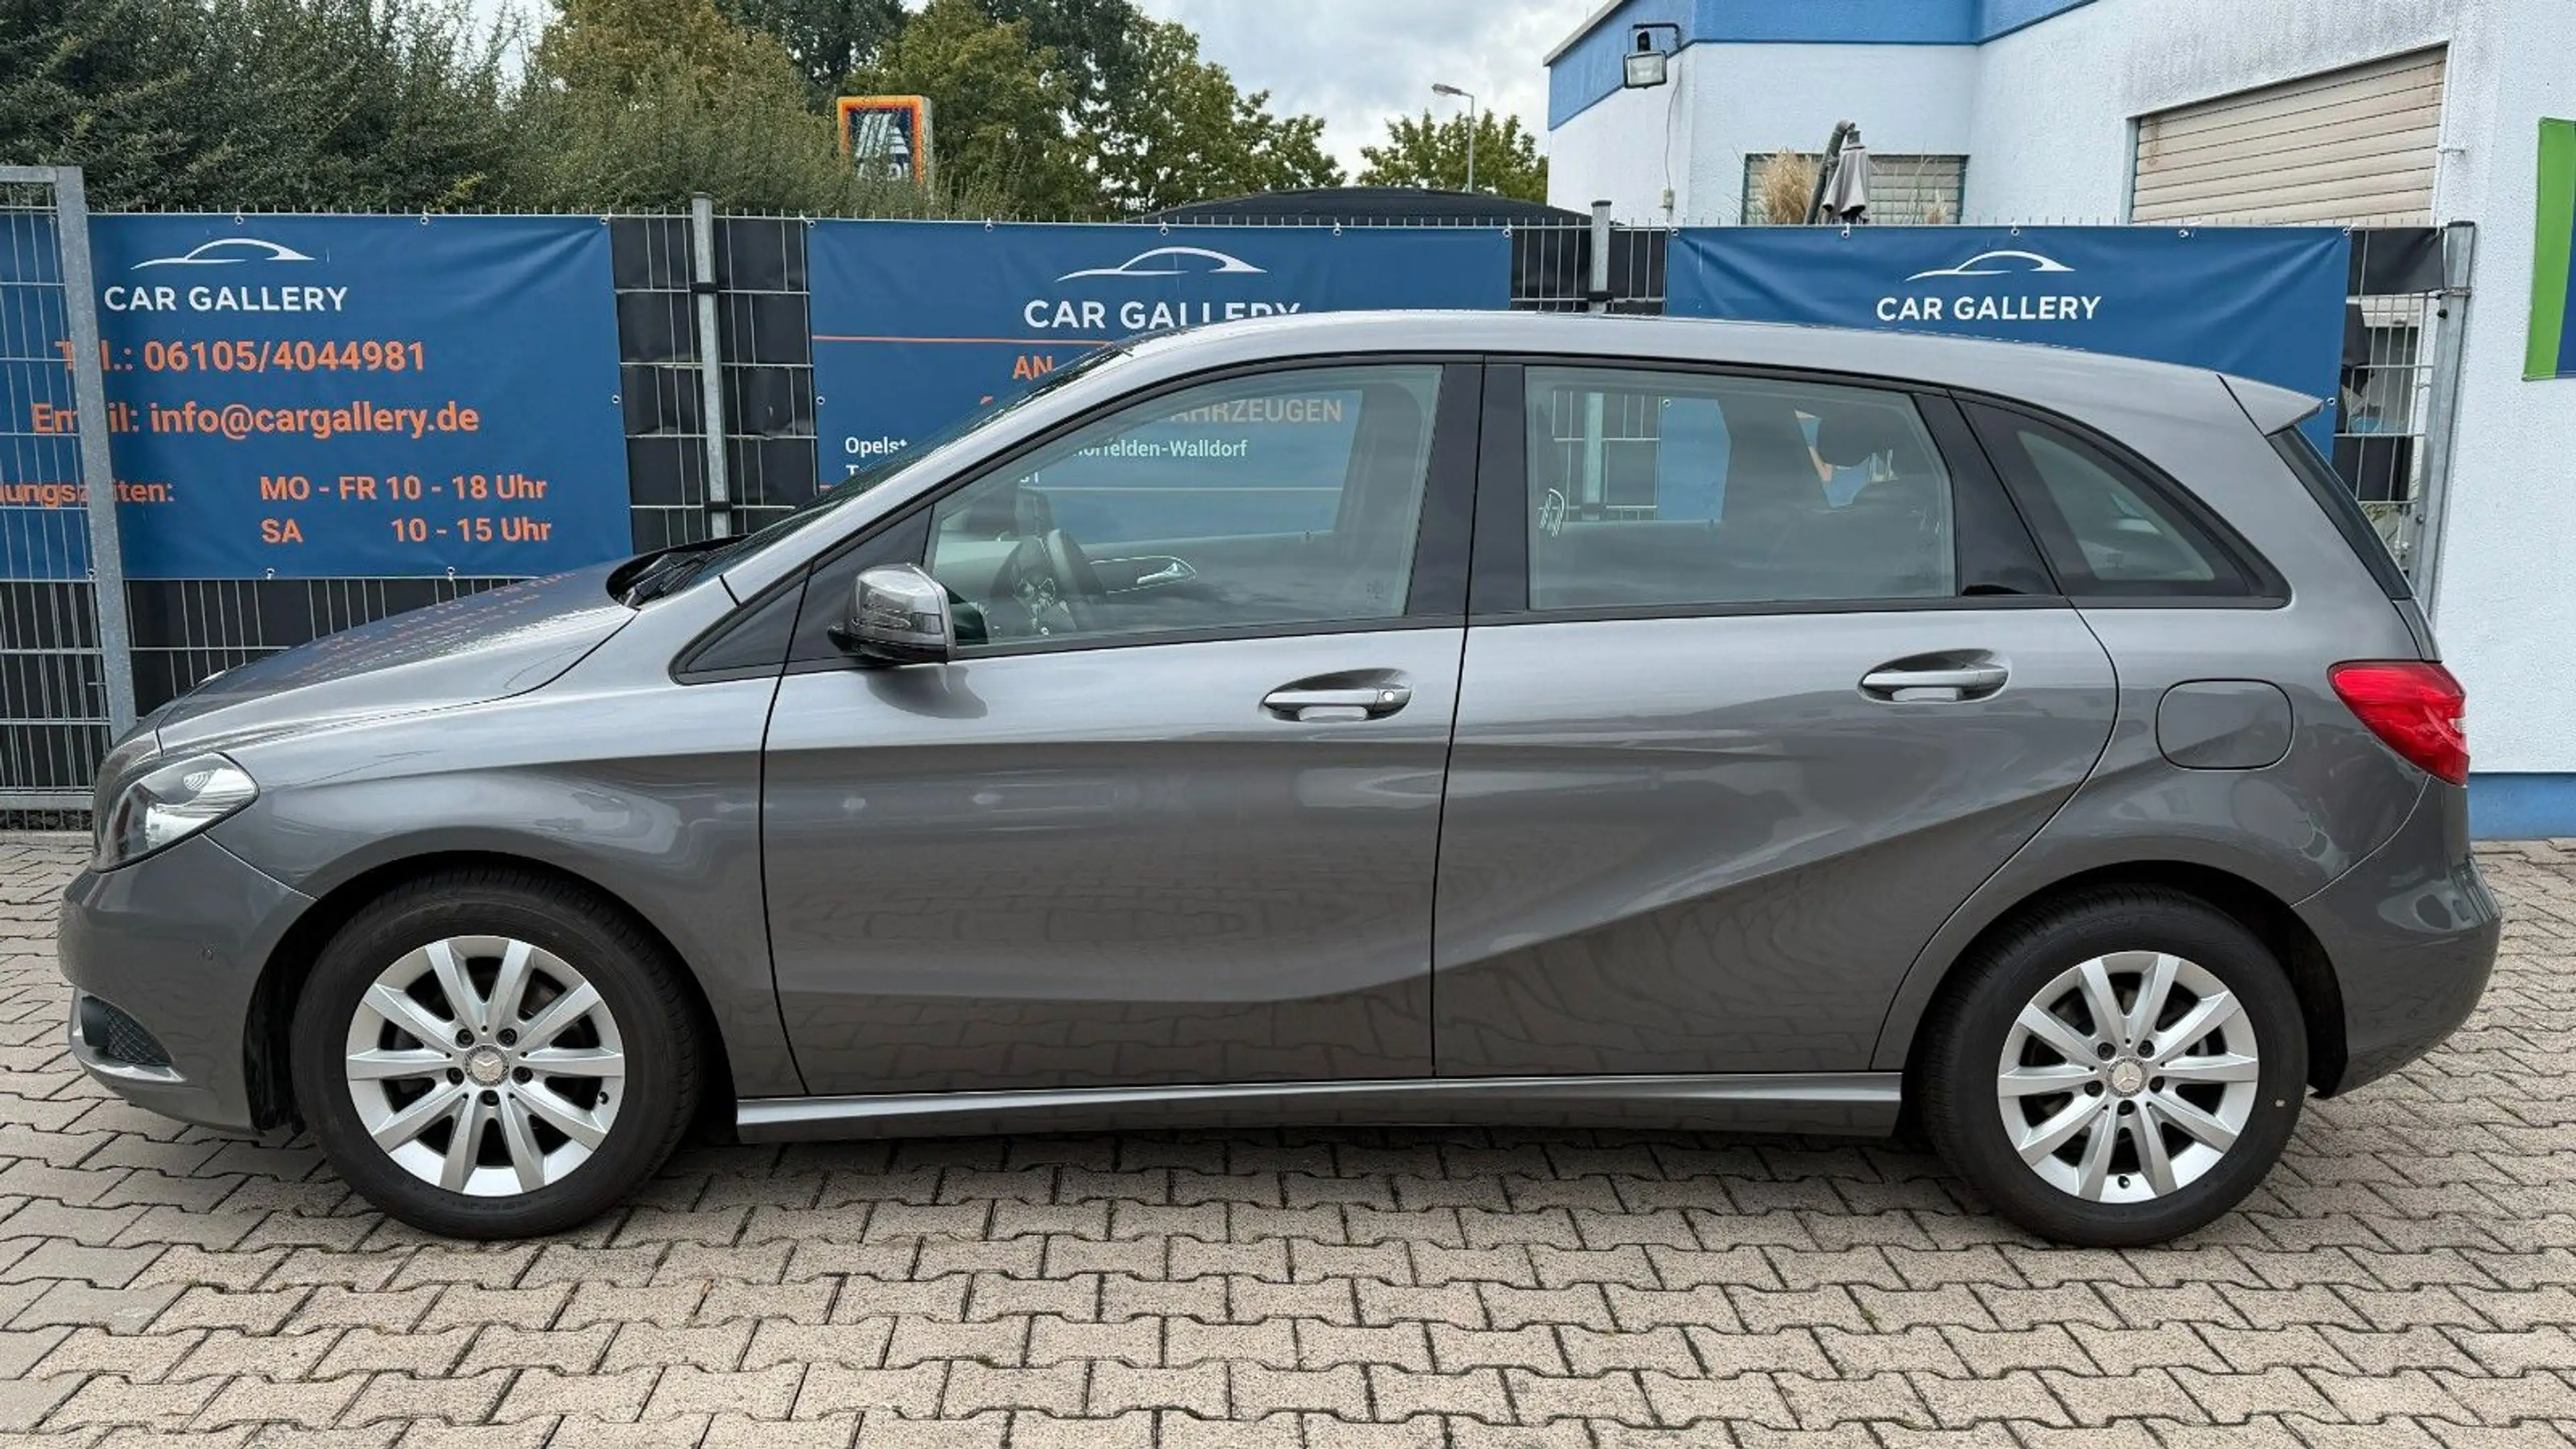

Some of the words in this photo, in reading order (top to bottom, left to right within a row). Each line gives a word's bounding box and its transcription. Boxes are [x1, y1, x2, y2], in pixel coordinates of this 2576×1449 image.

[105, 287, 176, 310] CAR
[189, 286, 347, 311] GALLERY
[1876, 297, 1943, 321] CAR
[1953, 296, 2102, 320] GALLERY
[1024, 300, 1106, 328] CAR
[54, 340, 133, 372] Tl.:
[144, 341, 425, 373] 06105/4044981
[32, 402, 140, 433] Emil:
[150, 400, 479, 440] info@cargallery.de
[1169, 399, 1342, 423] AHRZEUGEN
[260, 476, 311, 500] MO
[339, 476, 378, 500] FR
[386, 475, 422, 500] 10
[452, 475, 488, 500] 18
[496, 474, 547, 499] Uhr
[260, 519, 303, 543] SA
[391, 518, 427, 542] 10
[457, 517, 493, 542] 15
[501, 517, 551, 542] Uhr
